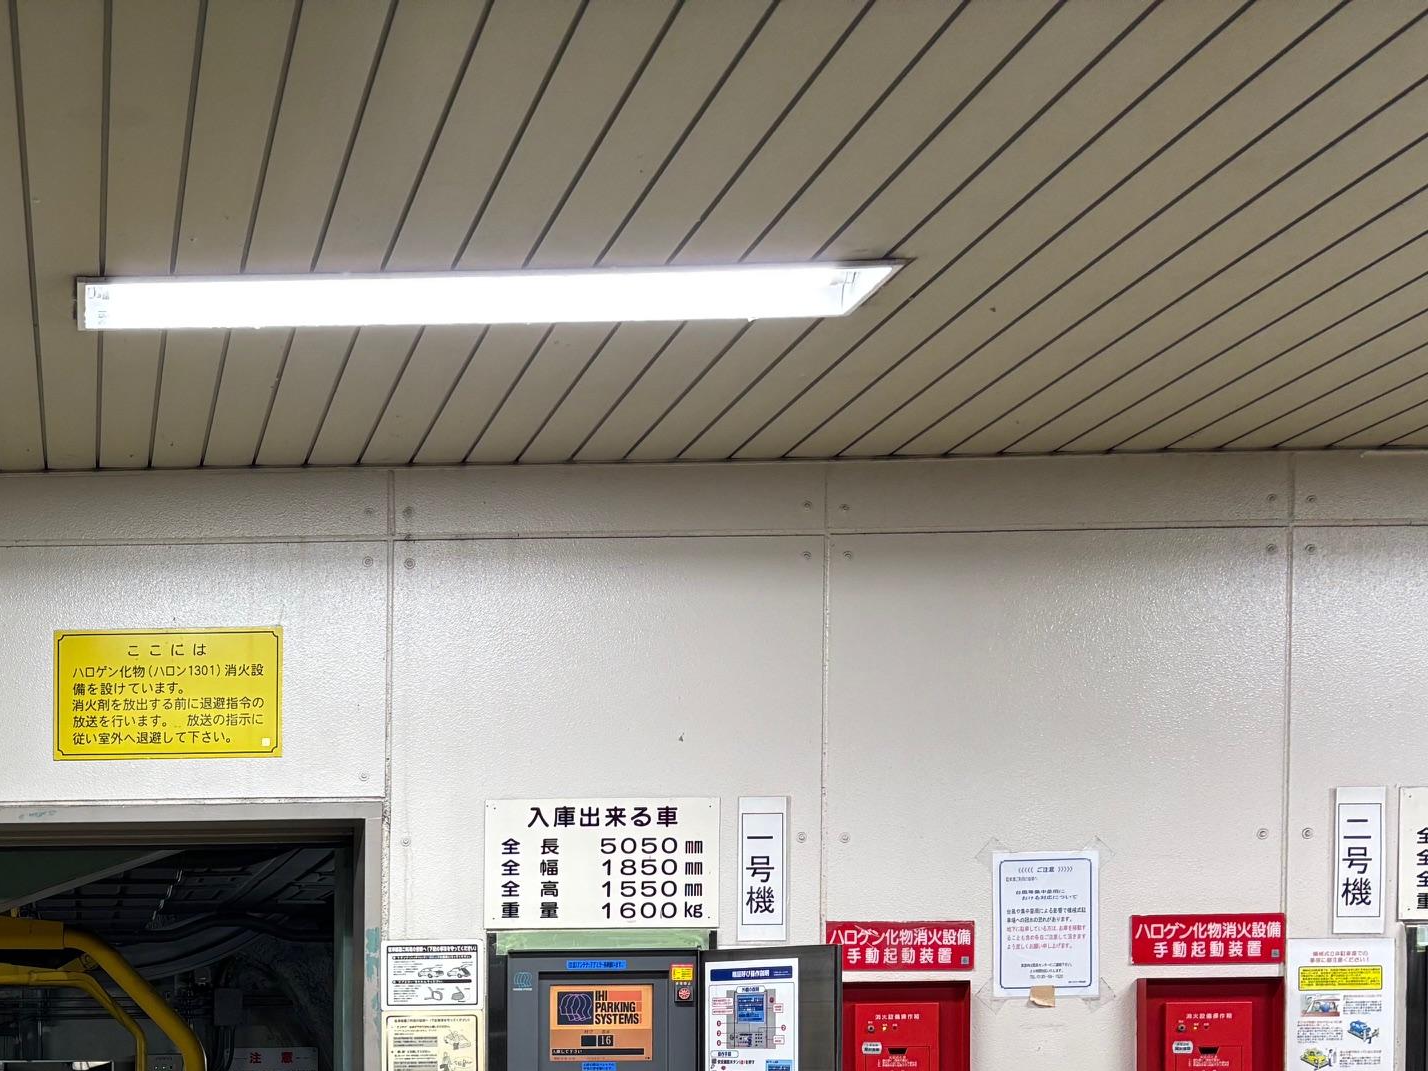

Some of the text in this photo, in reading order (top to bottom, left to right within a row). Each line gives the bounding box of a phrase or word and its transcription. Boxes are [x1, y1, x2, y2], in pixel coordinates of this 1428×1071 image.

[127, 643, 207, 657] ここには
[72, 681, 184, 696] 備を設けています。
[72, 696, 265, 712] 消火剤を放出する前に退避指令の
[72, 730, 232, 745] 従い室外へ退避して下さい。
[527, 805, 680, 828] 入庫出来る車
[1341, 818, 1373, 907] 二号機
[745, 834, 776, 916] 一号機
[829, 928, 972, 945] ハロゲン化物消火設備
[1134, 920, 1281, 939] ハロゲン化物消火設備
[846, 947, 953, 964] 手動起動装置
[1153, 940, 1262, 958] 手動起動装置
[594, 990, 608, 1002] IHI
[594, 1001, 636, 1013] PARKING
[594, 1013, 640, 1025] SYSTEMS
